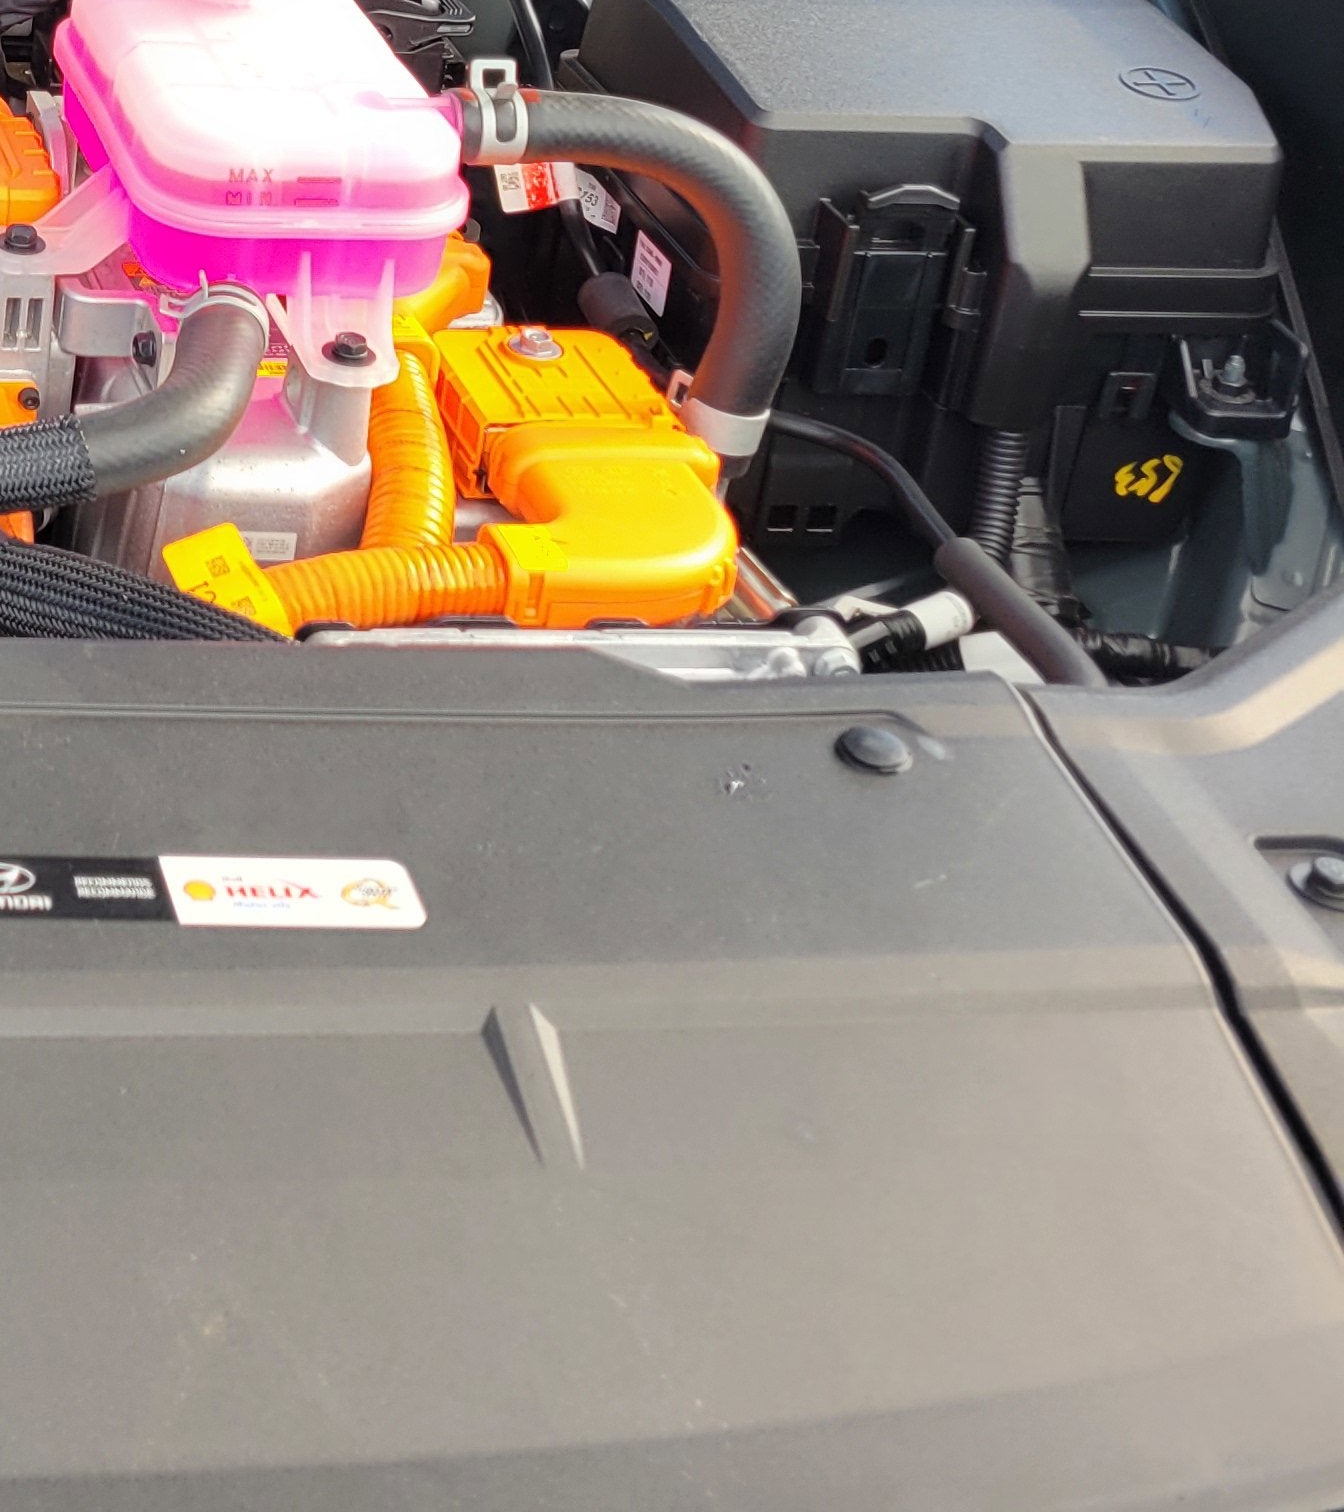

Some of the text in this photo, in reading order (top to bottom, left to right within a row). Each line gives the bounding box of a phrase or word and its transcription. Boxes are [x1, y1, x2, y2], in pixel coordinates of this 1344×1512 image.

[228, 168, 273, 183] MAX
[225, 190, 272, 206] MIN
[225, 882, 319, 899] HELIX
